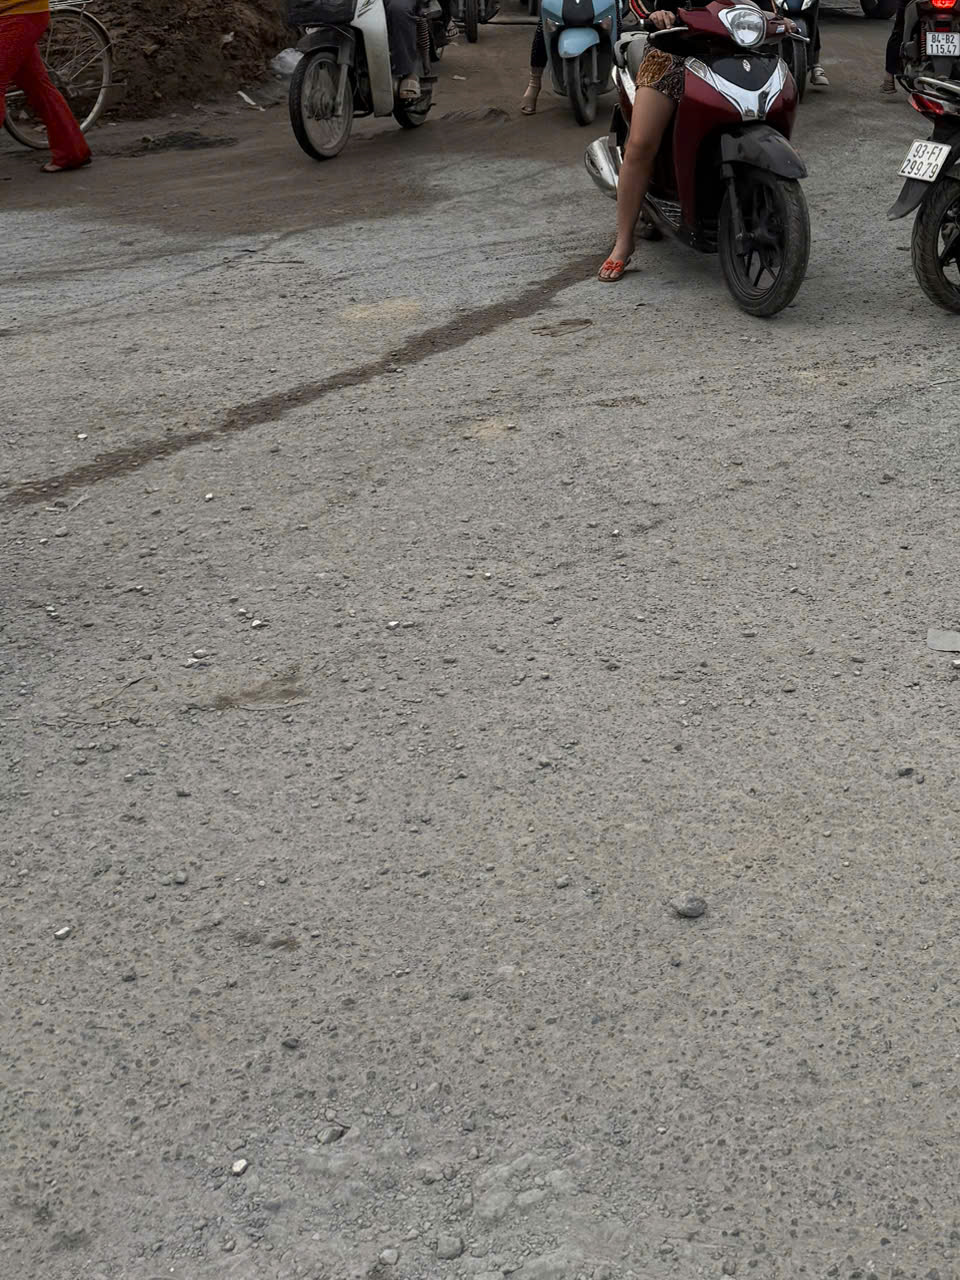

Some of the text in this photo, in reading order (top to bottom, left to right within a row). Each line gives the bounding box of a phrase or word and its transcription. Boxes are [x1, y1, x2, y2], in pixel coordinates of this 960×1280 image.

[931, 34, 955, 44] 84-B2
[930, 44, 957, 55] 115.47
[913, 143, 943, 162] 93-F1
[900, 158, 939, 179] 299.79
